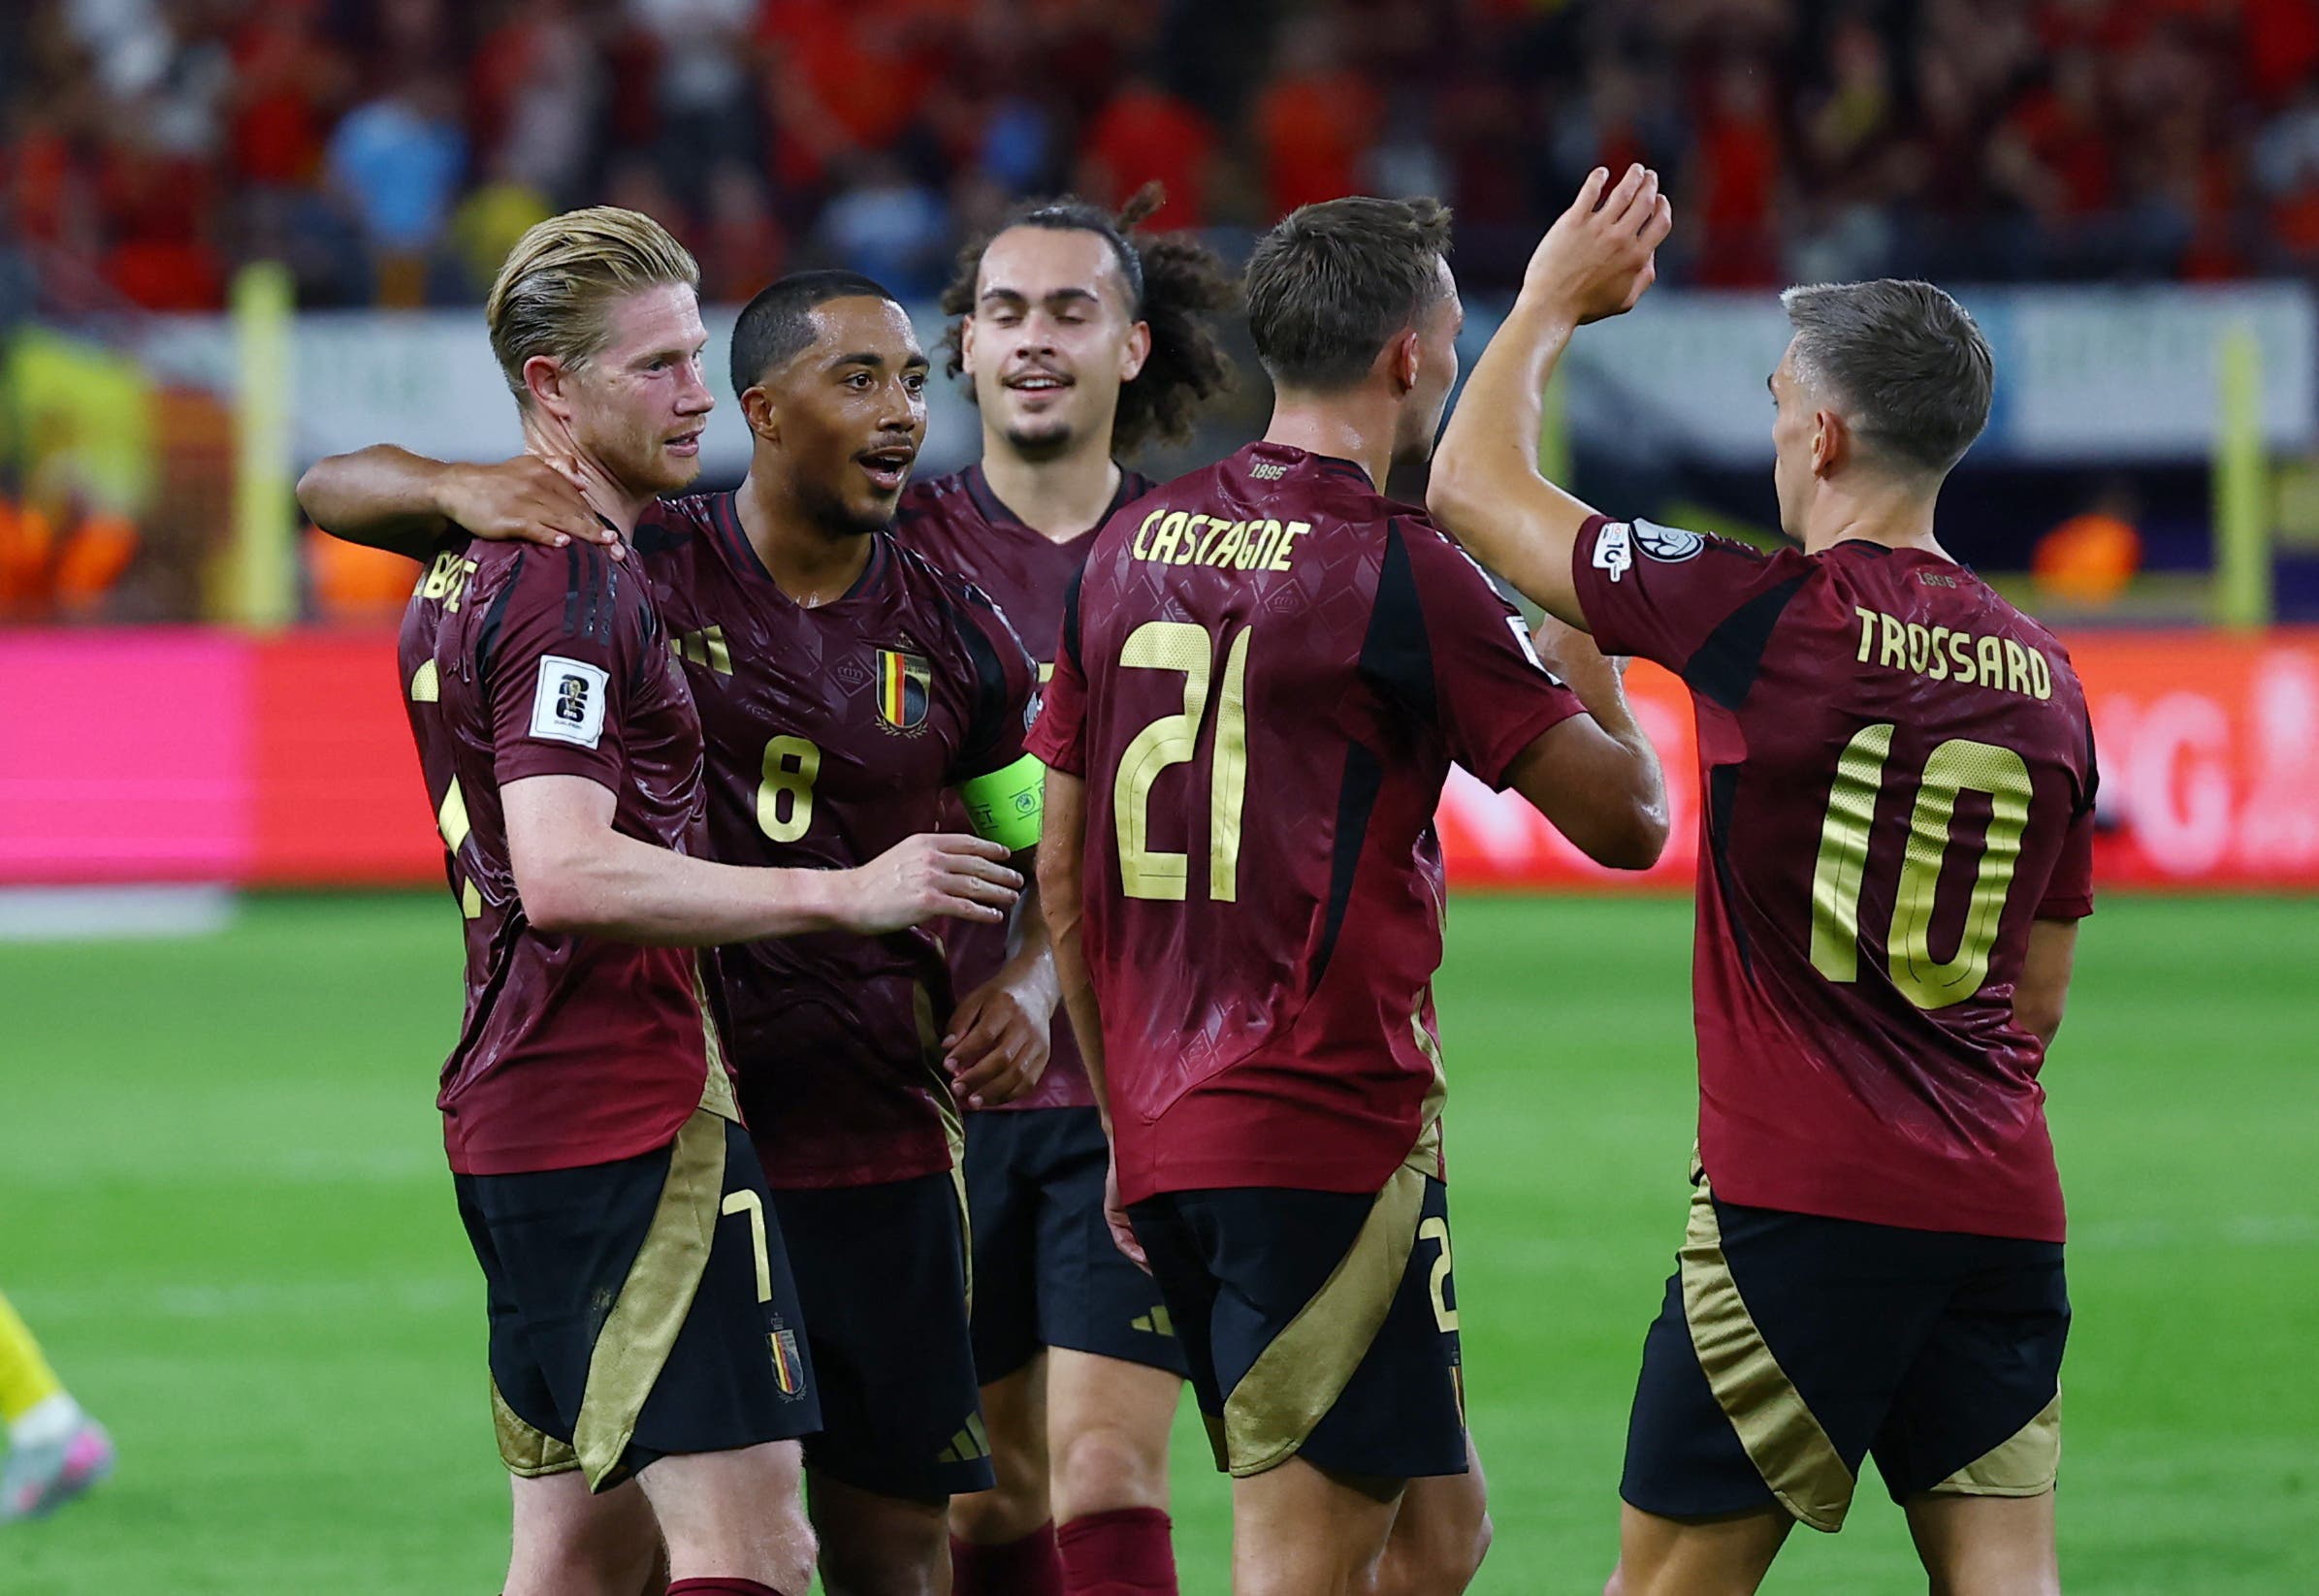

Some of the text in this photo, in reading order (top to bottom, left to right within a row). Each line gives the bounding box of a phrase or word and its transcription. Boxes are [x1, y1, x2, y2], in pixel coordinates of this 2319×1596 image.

[1249, 463, 1287, 481] 1895
[1133, 509, 1311, 571] CASTAGNE
[1854, 606, 2052, 700] TROSSARD
[757, 734, 821, 844] 8
[1113, 621, 1253, 903] 21
[1810, 723, 2034, 1010] 10
[722, 1189, 773, 1304] 7
